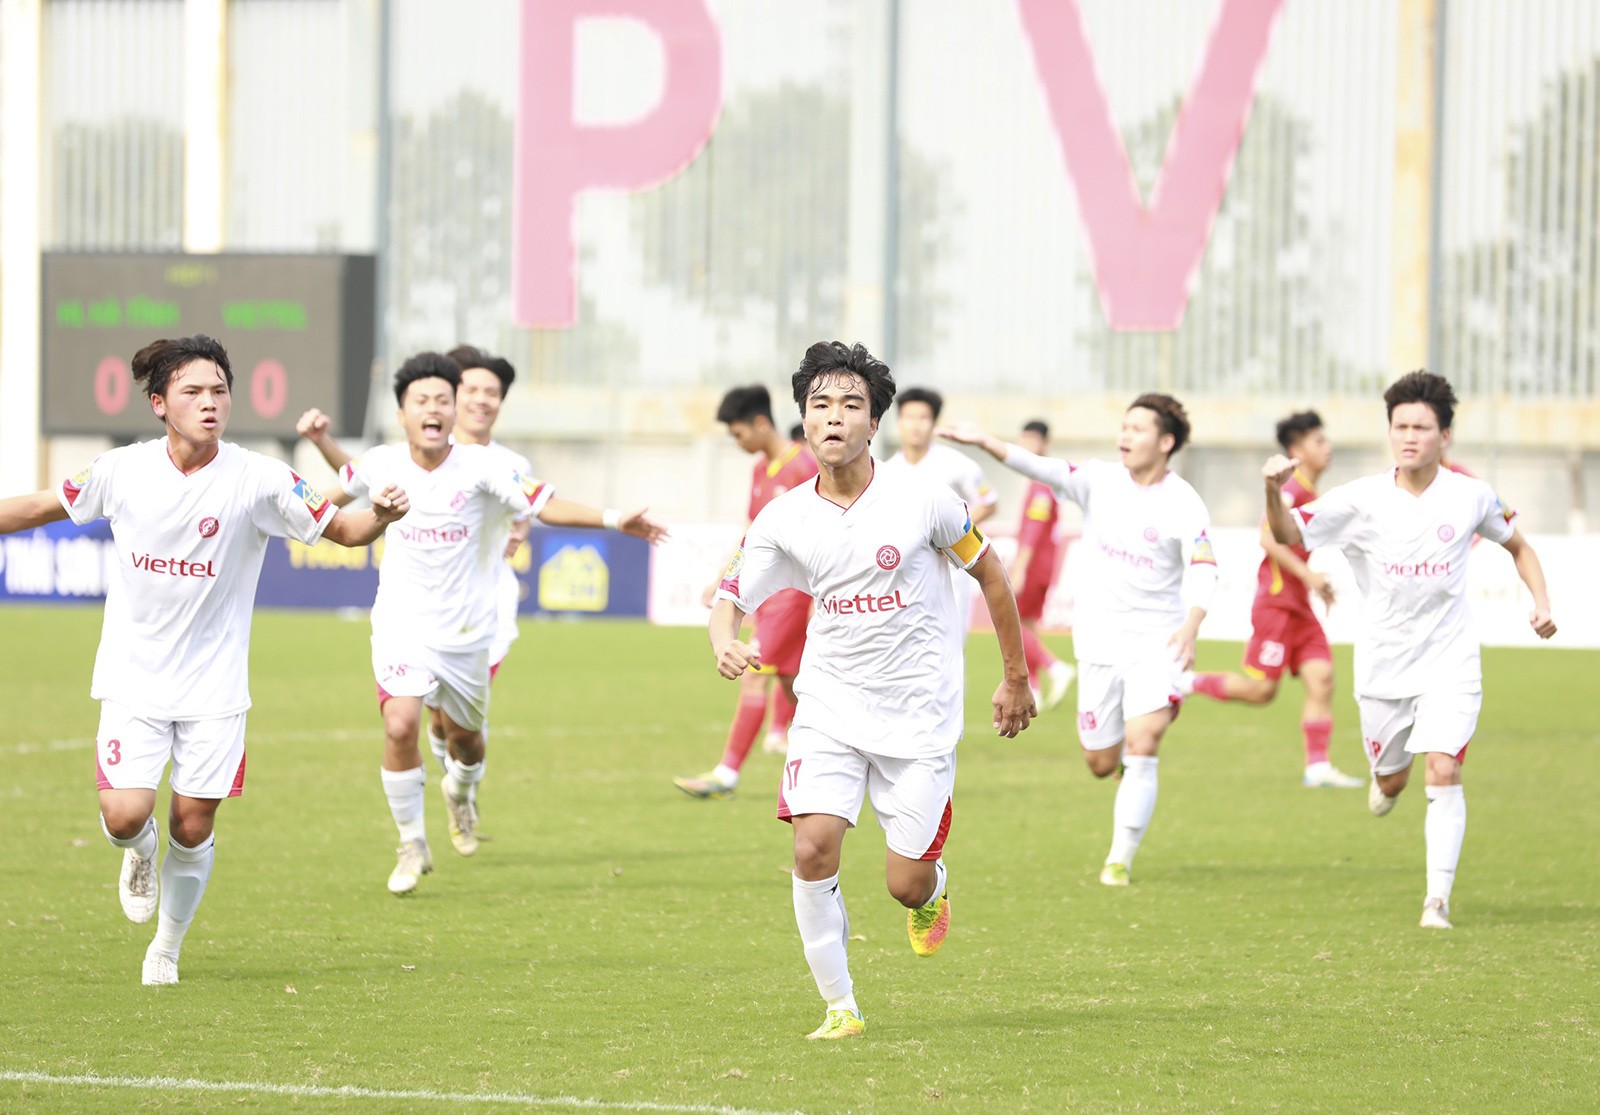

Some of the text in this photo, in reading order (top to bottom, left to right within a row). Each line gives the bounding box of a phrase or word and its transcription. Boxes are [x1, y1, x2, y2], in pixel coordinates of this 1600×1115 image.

[512, 0, 1284, 332] P V
[94, 354, 131, 417] 0
[251, 357, 288, 420] 0
[131, 551, 216, 577] viettel
[820, 589, 907, 615] viettel
[107, 738, 122, 766] 3
[785, 758, 802, 791] 17
